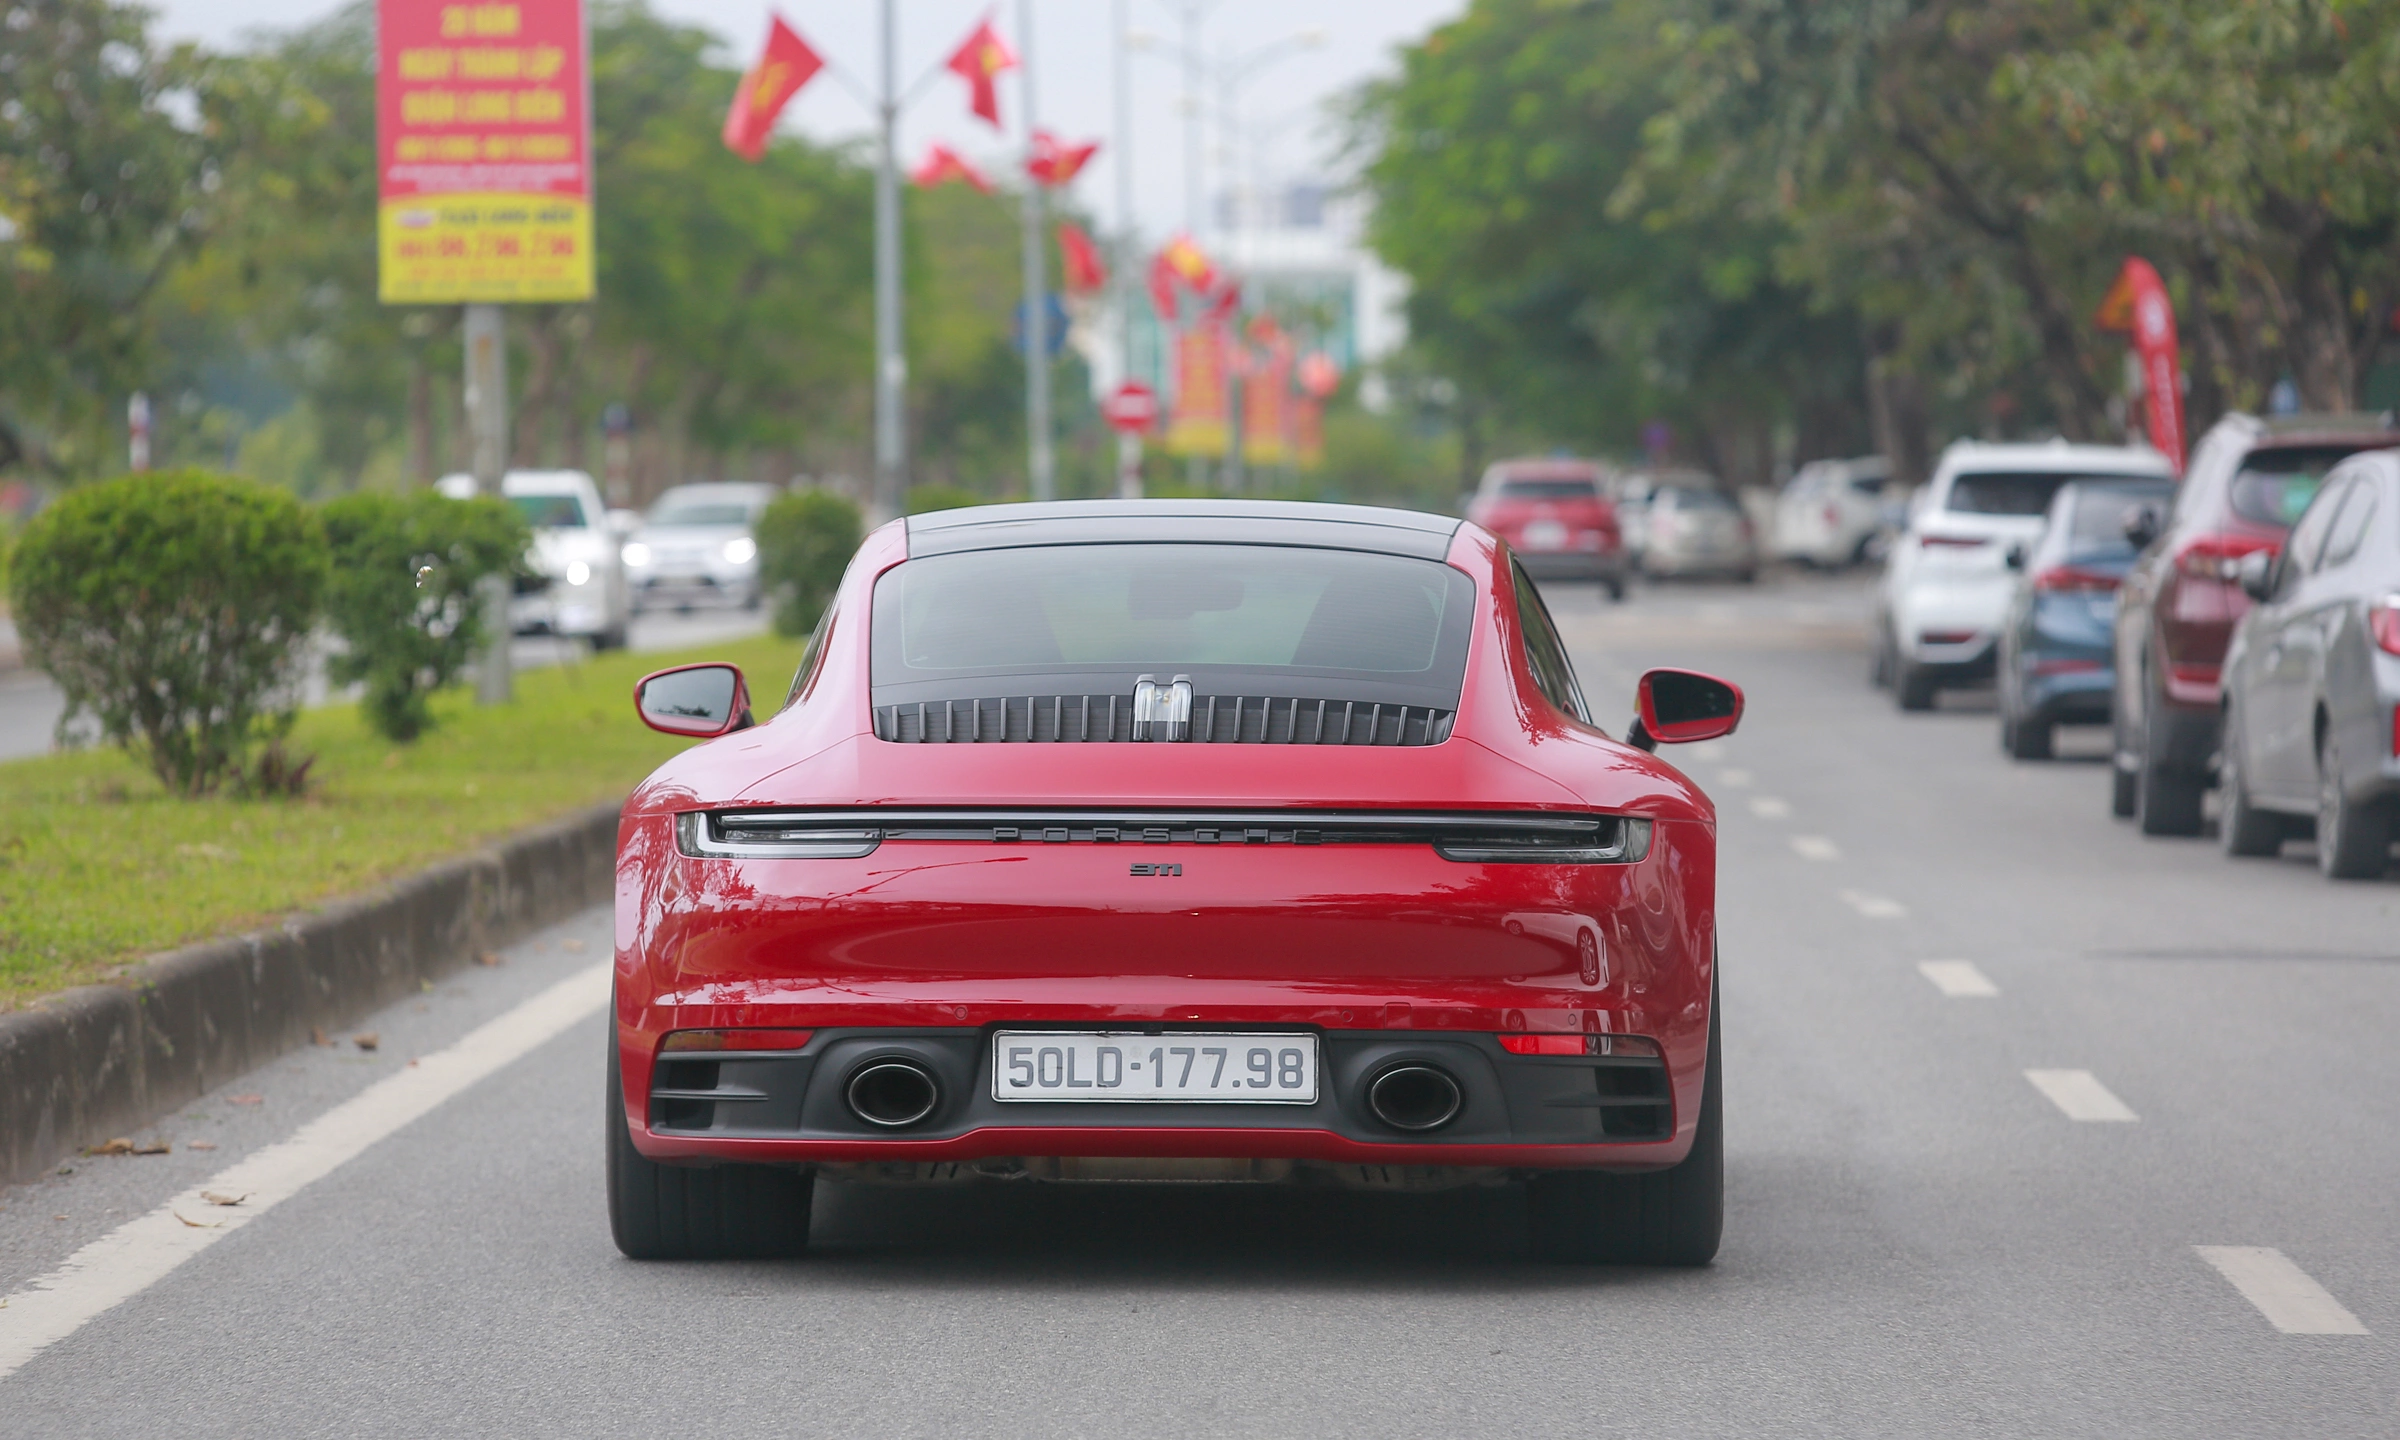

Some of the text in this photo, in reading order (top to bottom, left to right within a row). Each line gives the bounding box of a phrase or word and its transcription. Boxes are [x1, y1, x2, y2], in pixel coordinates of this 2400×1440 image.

[992, 827, 1322, 845] PORSCHE
[1129, 862, 1182, 877] 911
[1009, 1047, 1304, 1089] 50LD-177.98
